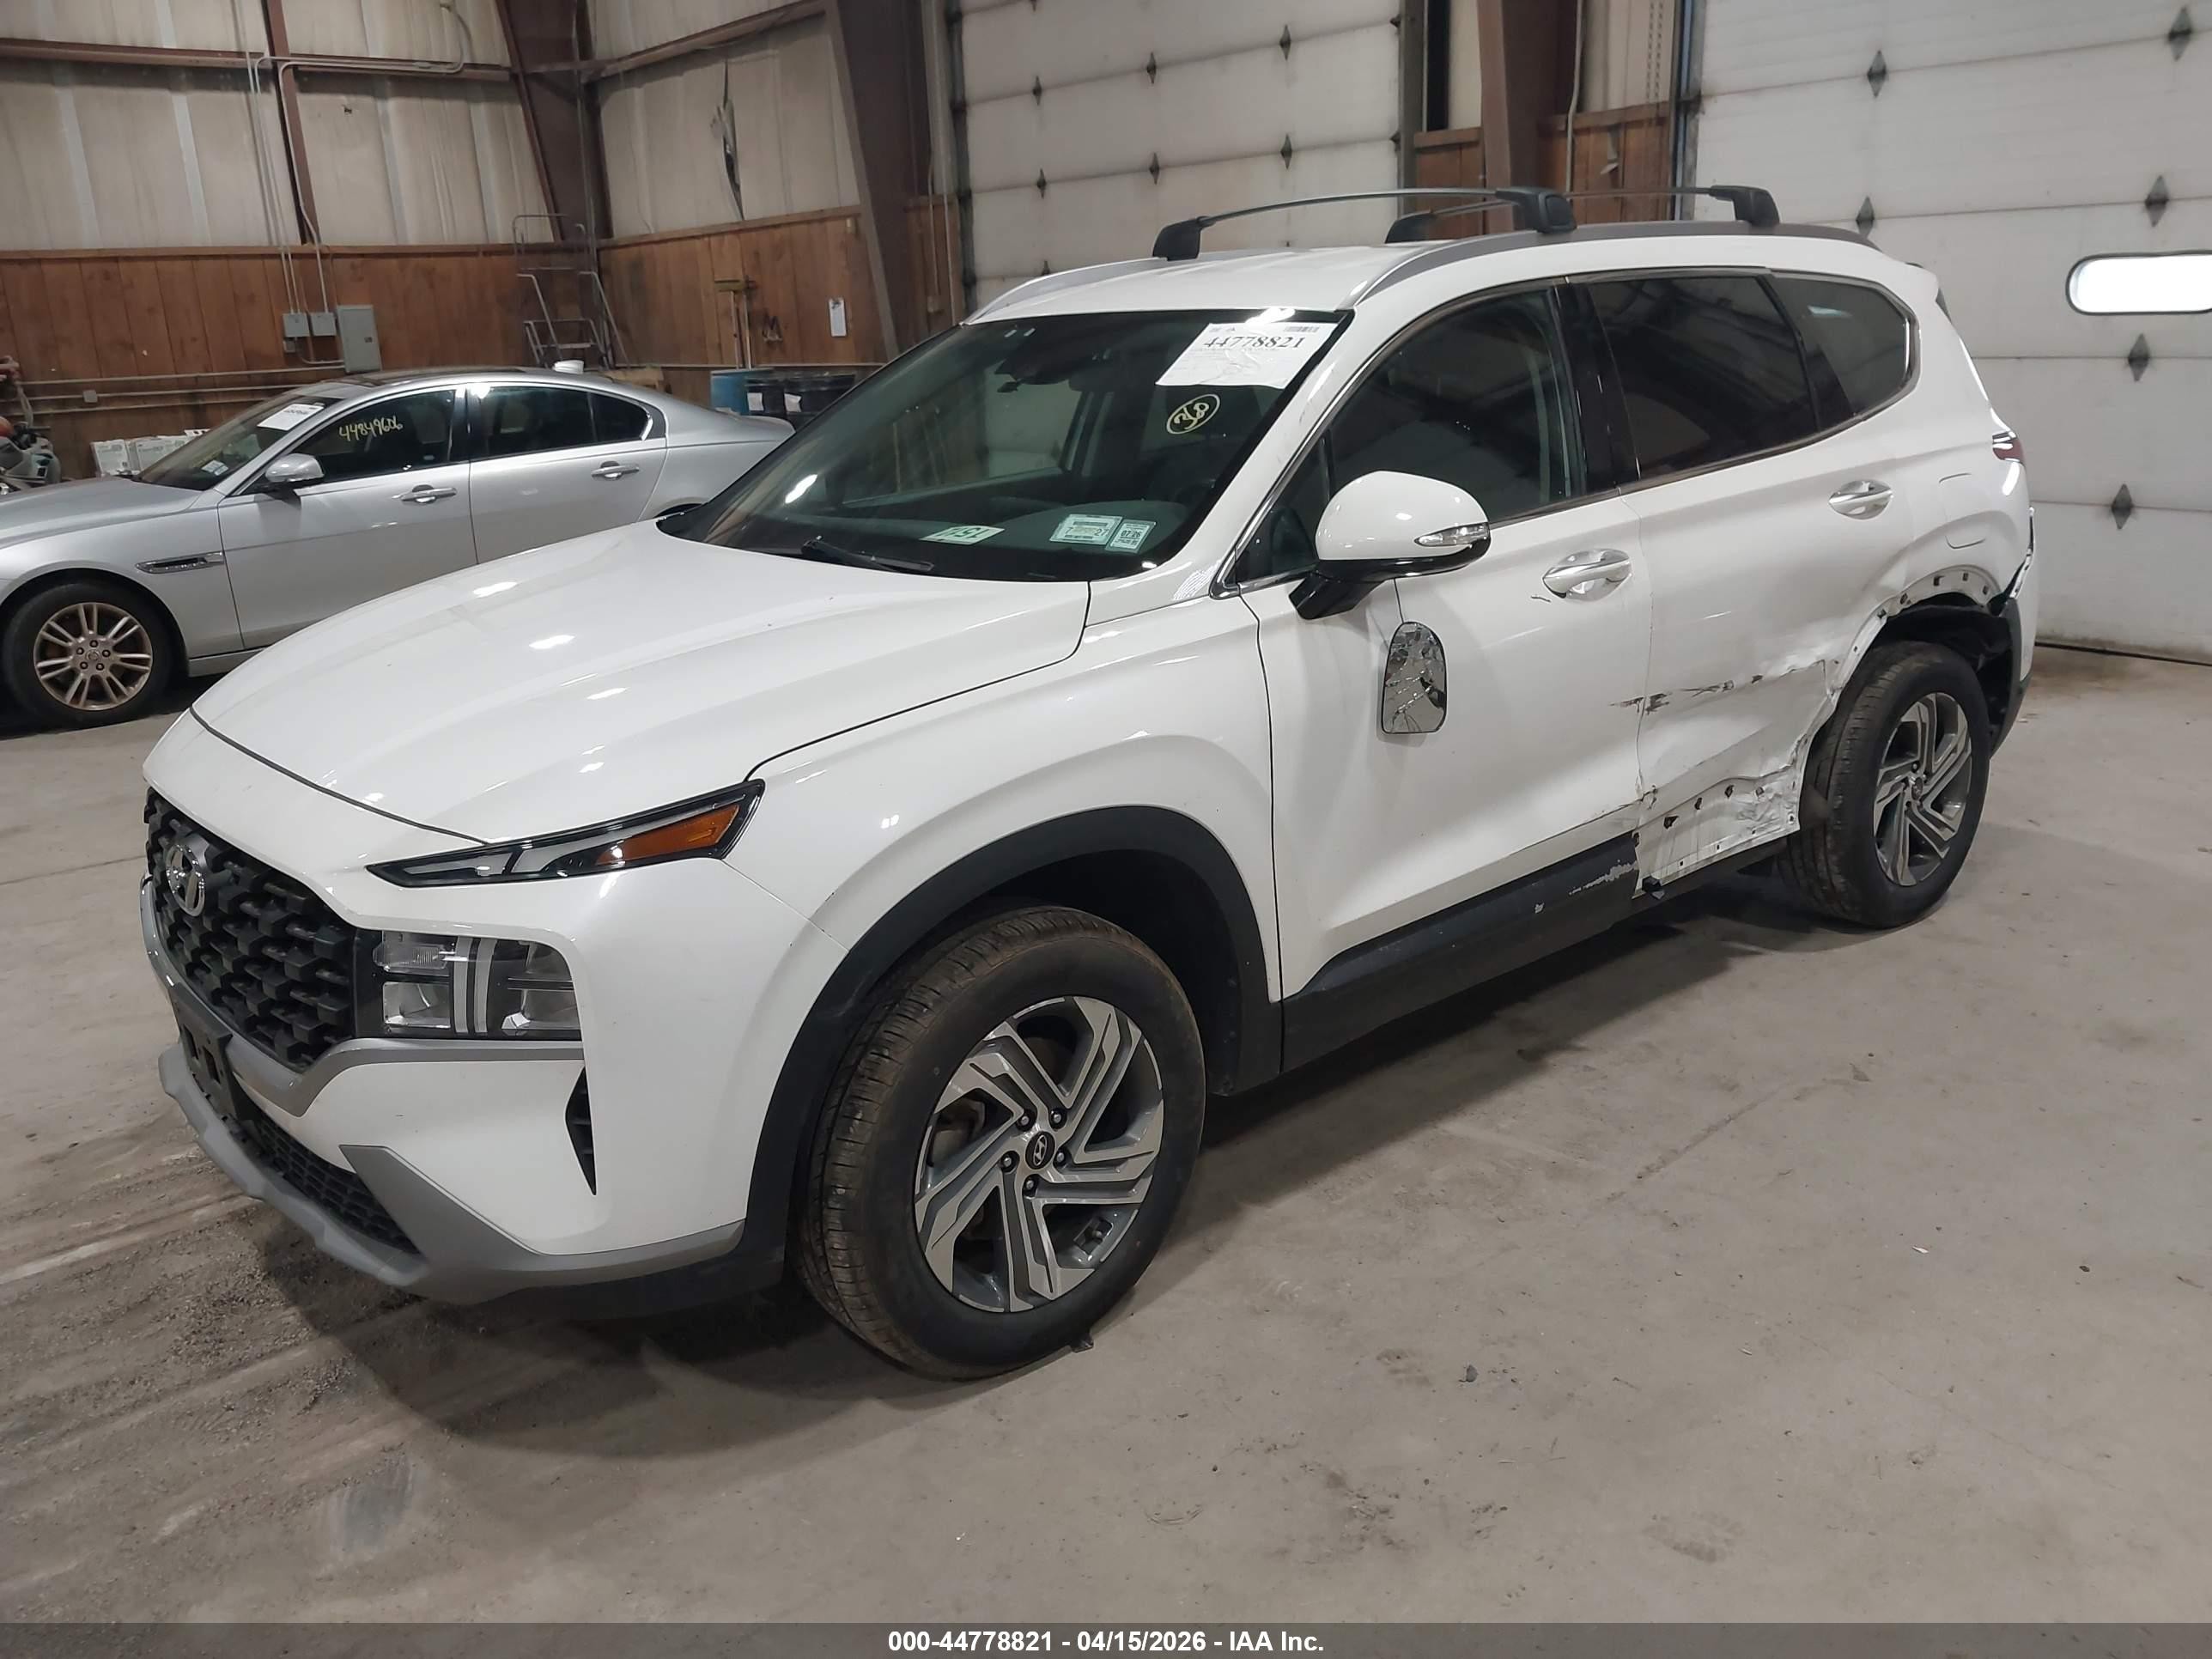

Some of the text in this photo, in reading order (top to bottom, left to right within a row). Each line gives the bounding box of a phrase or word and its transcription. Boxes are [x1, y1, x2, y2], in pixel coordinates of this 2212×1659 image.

[1203, 336, 1305, 348] 44778821
[338, 415, 404, 441] 44849606
[1093, 528, 1109, 537] 27
